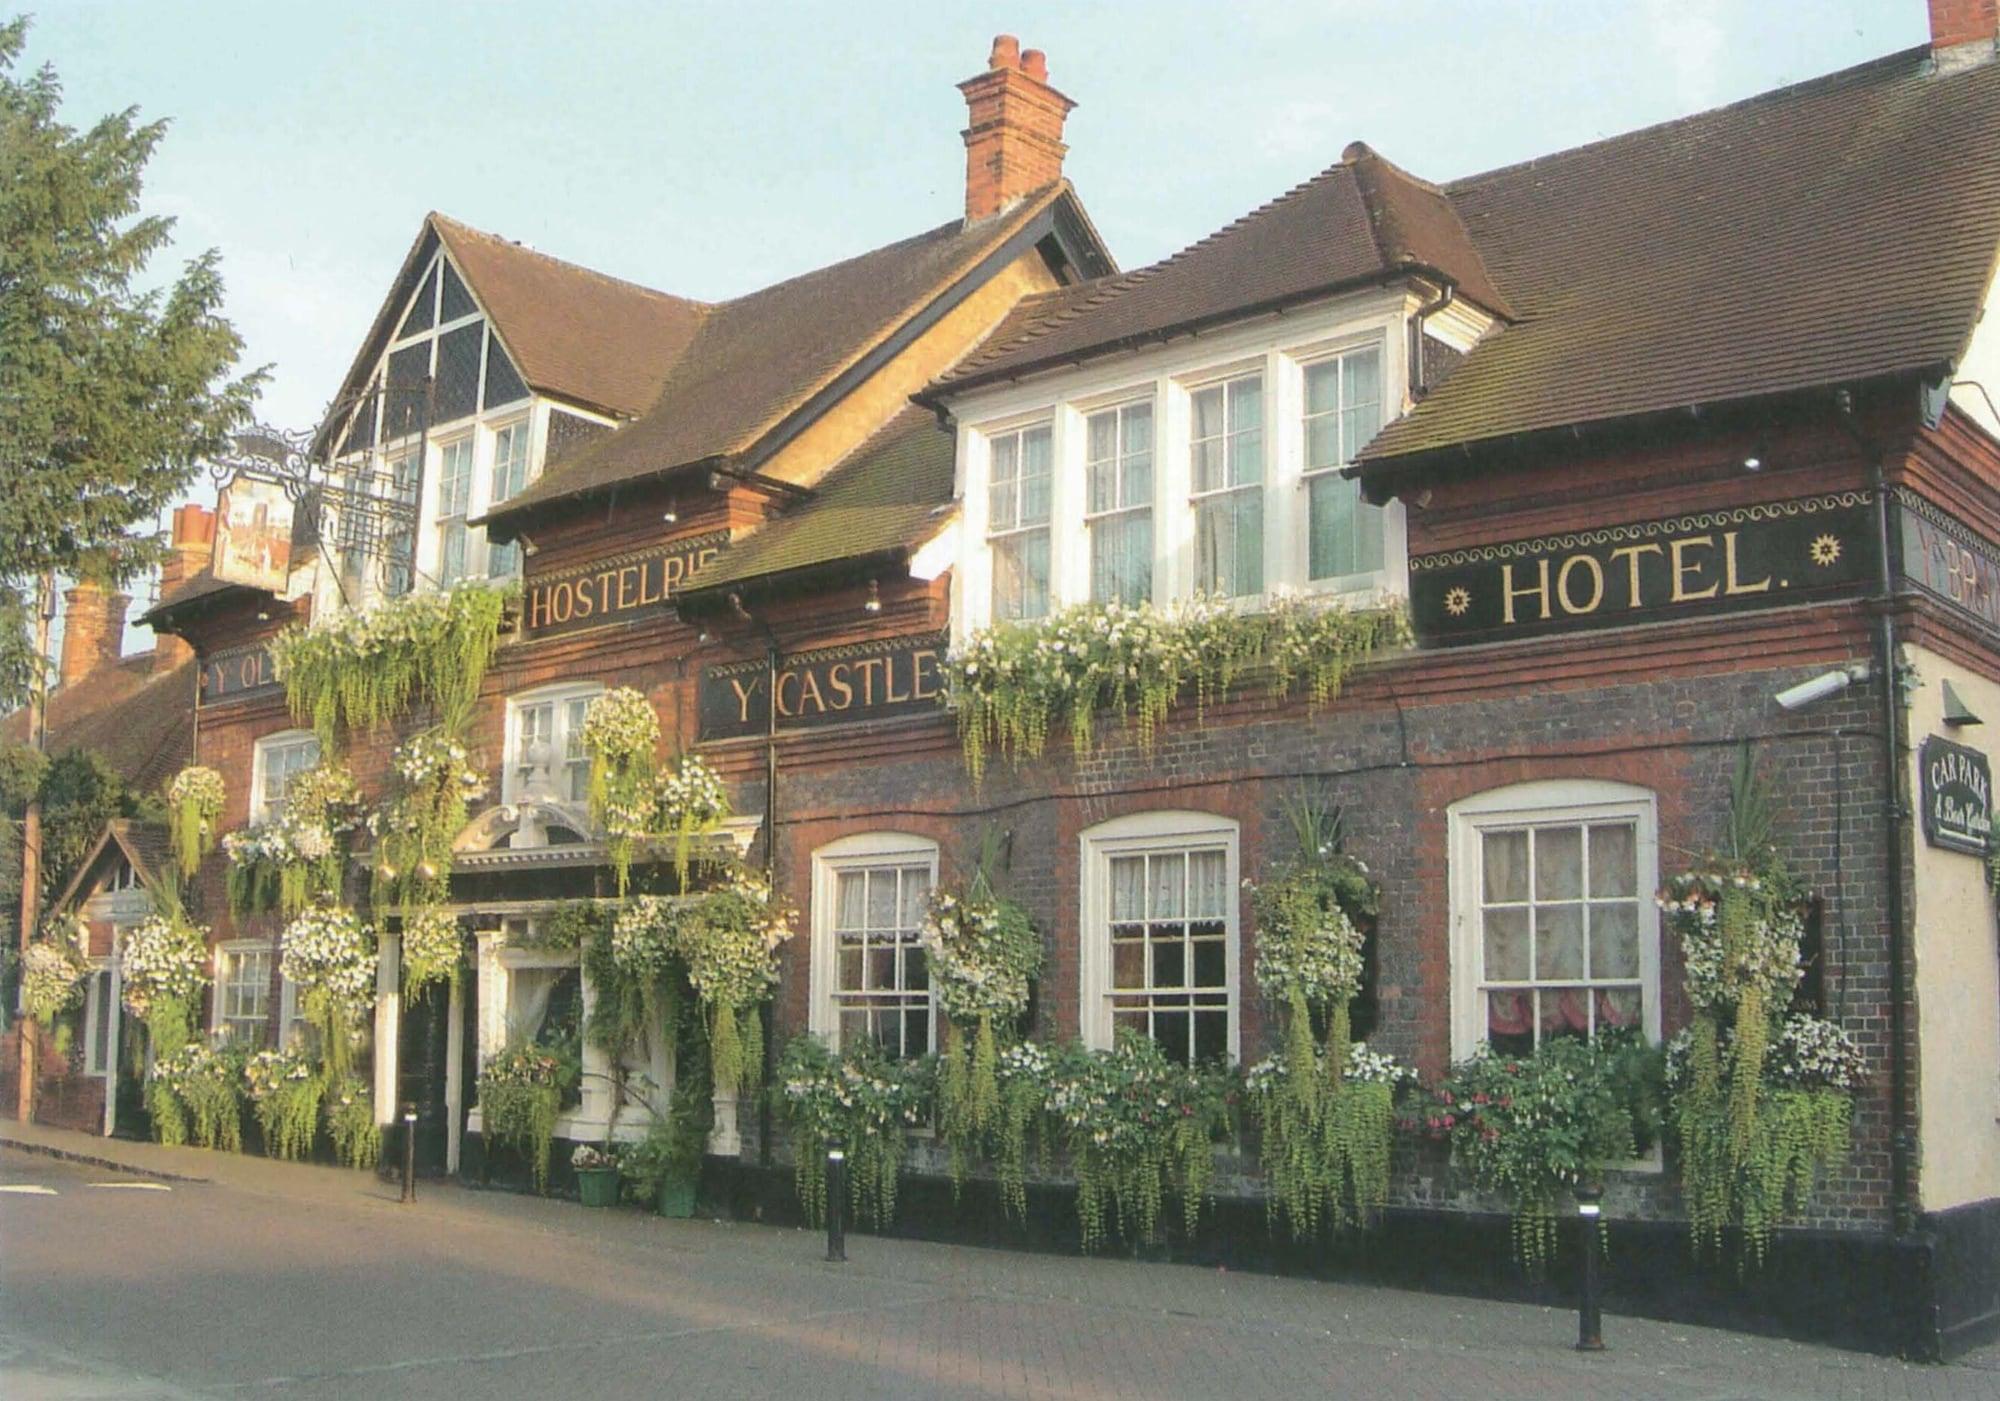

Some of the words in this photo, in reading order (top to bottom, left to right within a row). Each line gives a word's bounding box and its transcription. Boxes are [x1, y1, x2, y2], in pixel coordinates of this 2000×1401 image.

[1502, 532, 1789, 623] HOTEL.
[776, 651, 938, 716] CASTLE
[1932, 753, 1957, 790] CAR
[1959, 755, 1987, 808] PARK
